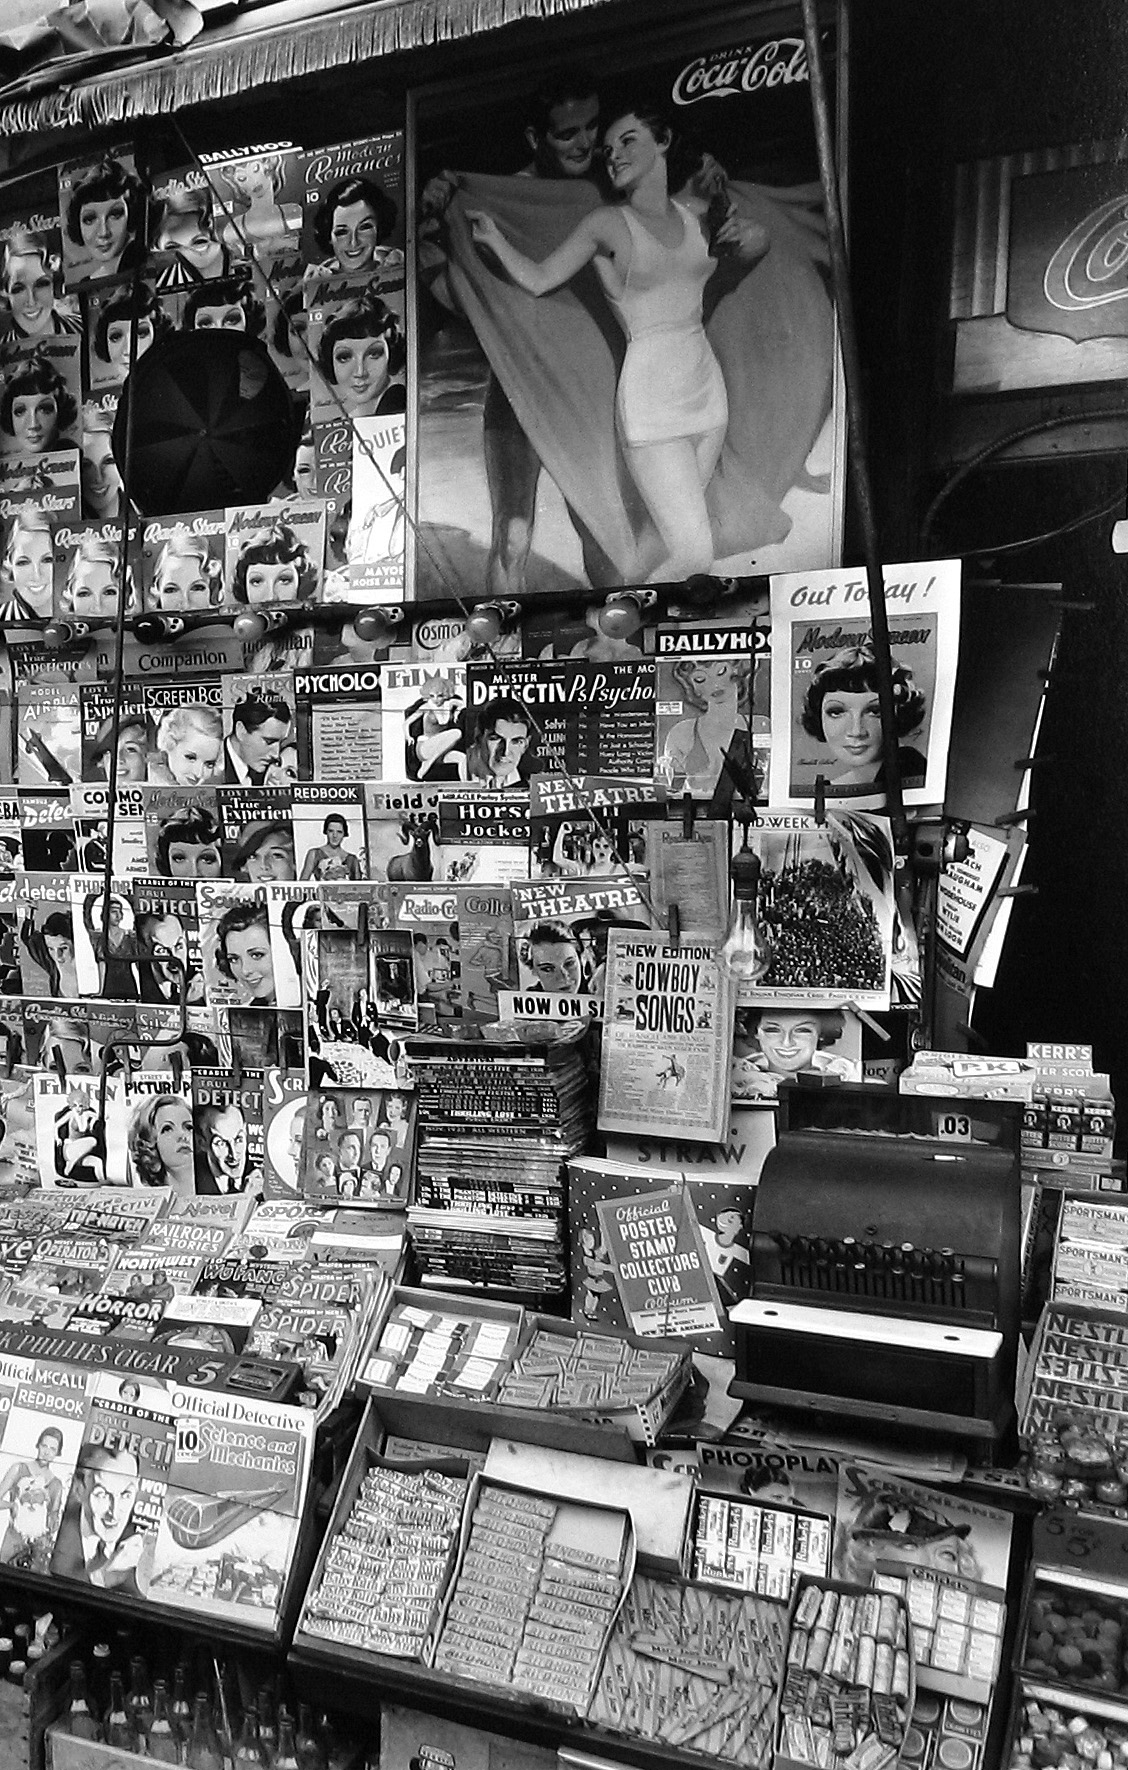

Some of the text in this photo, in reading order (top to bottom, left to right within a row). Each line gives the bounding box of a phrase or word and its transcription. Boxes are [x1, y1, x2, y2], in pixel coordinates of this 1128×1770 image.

[198, 140, 293, 164] BALLYHOO
[306, 192, 320, 204] 10
[309, 311, 323, 322] 10
[790, 584, 837, 607] Out
[138, 651, 228, 672] Companion
[613, 665, 633, 675] THE
[794, 660, 812, 670] 10
[295, 671, 378, 694] PSYCHOLO
[473, 680, 566, 706] DETECTIV
[146, 684, 195, 706] SCREEN
[230, 797, 259, 809] True
[293, 786, 358, 800] REDBOOK
[540, 786, 659, 814] THEATRE
[222, 804, 292, 823] Experien
[522, 884, 567, 901] NEW
[522, 887, 642, 919] THEATRE
[137, 899, 198, 916] DETECT
[625, 943, 711, 960] NEW EDITION
[635, 961, 700, 994] COWBOY
[513, 996, 582, 1018] NOW ON
[635, 994, 696, 1034] SONGS
[1027, 1045, 1092, 1060] KERR'S
[960, 1062, 1018, 1073] P.K.
[197, 1088, 261, 1109] DETECT
[940, 1116, 970, 1135] .03
[638, 1143, 747, 1166] STRAW
[616, 1200, 671, 1223] Official
[149, 1222, 225, 1243] RAILROAD
[619, 1215, 678, 1242] POSTER
[161, 1237, 221, 1253] STORIES
[629, 1236, 676, 1260] STAMP
[117, 1255, 203, 1271] NORTHWEST
[619, 1251, 701, 1281] COLLECTORS
[285, 1275, 362, 1303] SPIDER
[5, 1291, 77, 1318] WEST
[79, 1295, 165, 1322] HORROR
[263, 1309, 347, 1338] SPIDER
[113, 1350, 181, 1375] CIGAR
[17, 1387, 85, 1417] REDBOOK
[171, 1391, 306, 1432] Official Detective
[178, 1430, 198, 1451] 10
[267, 1438, 297, 1455] and
[209, 1447, 296, 1476] Mechanics
